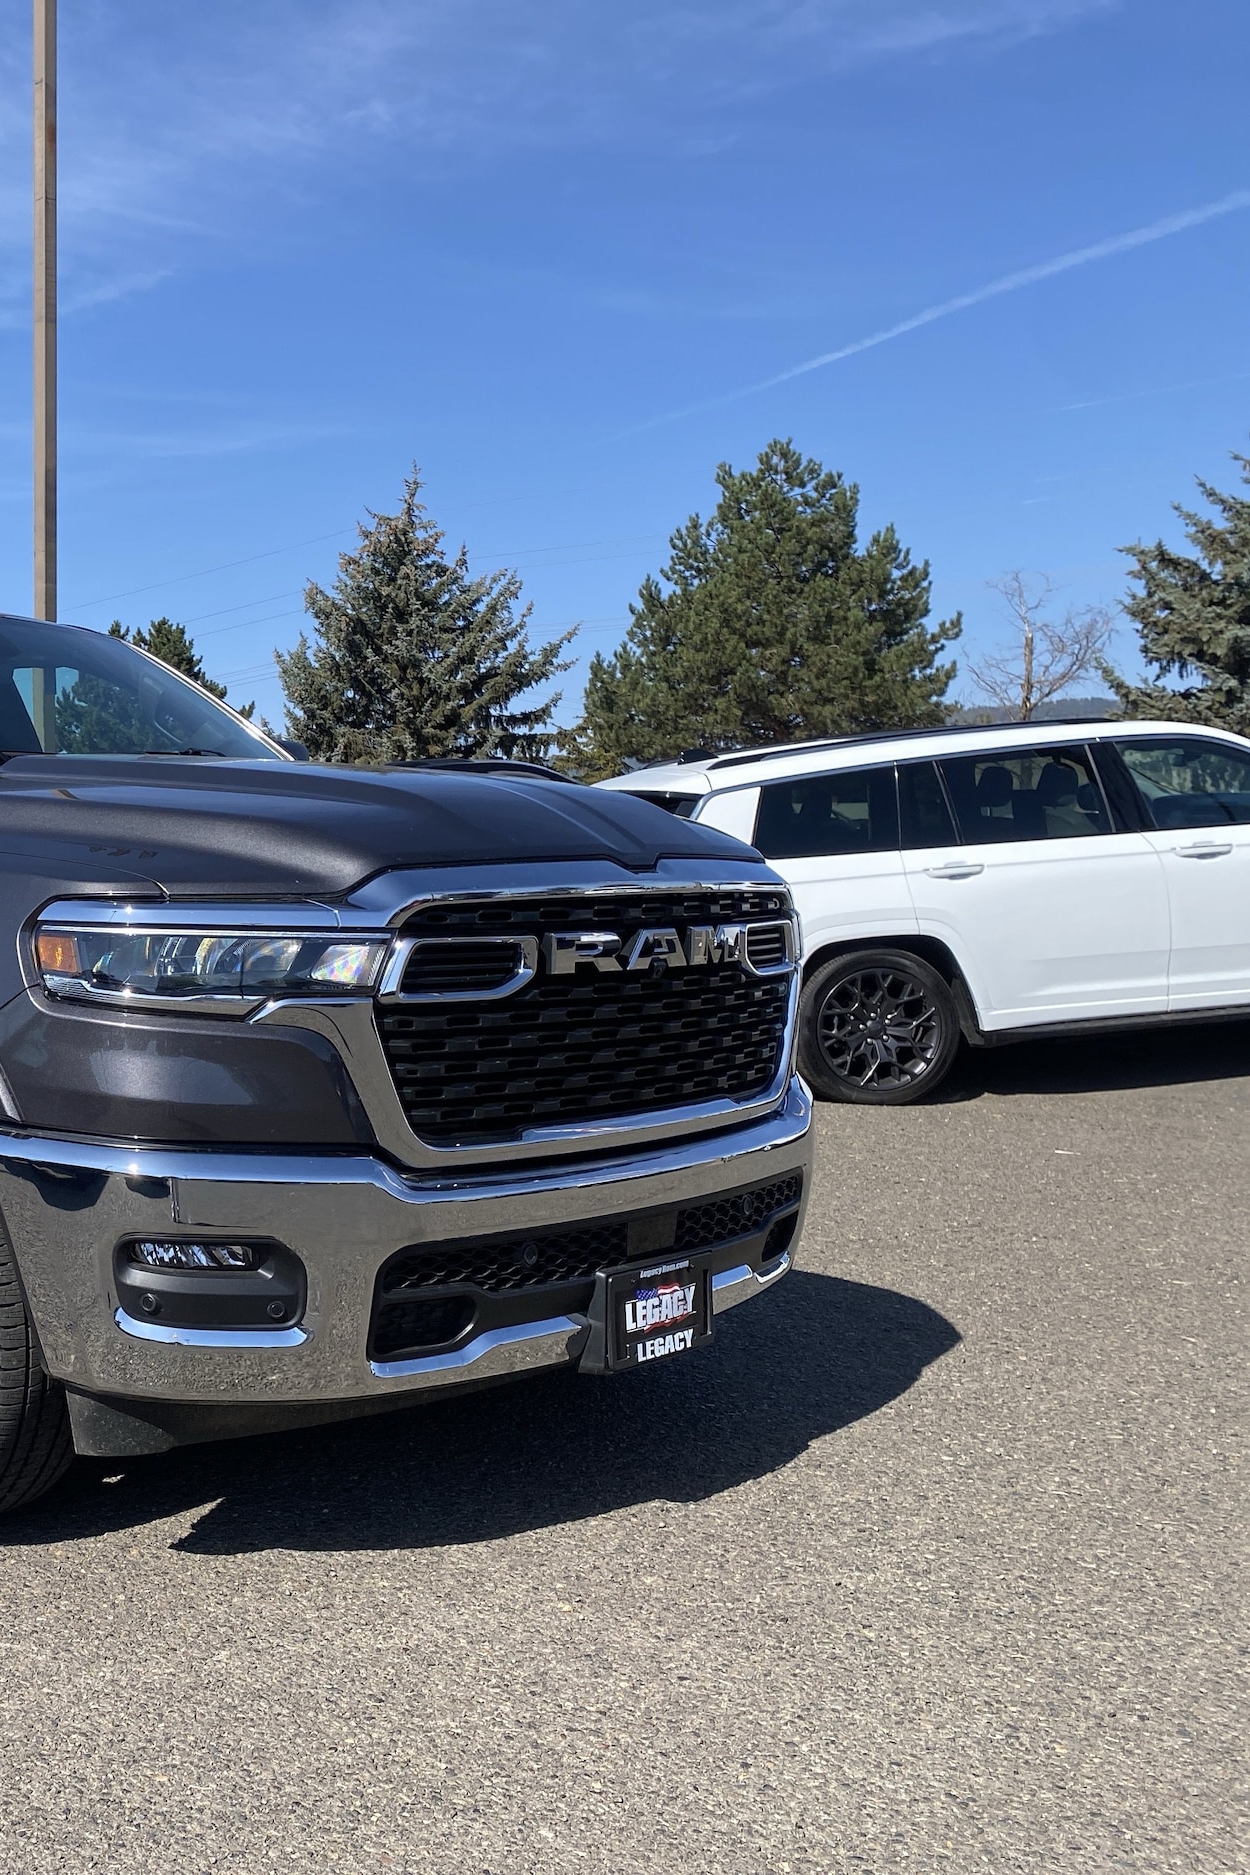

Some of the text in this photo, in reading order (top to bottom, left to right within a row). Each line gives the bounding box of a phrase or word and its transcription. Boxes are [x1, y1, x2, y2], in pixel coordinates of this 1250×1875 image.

[545, 925, 745, 975] RAM
[625, 1285, 696, 1331] LEGACY
[637, 1328, 694, 1363] LEGACY
